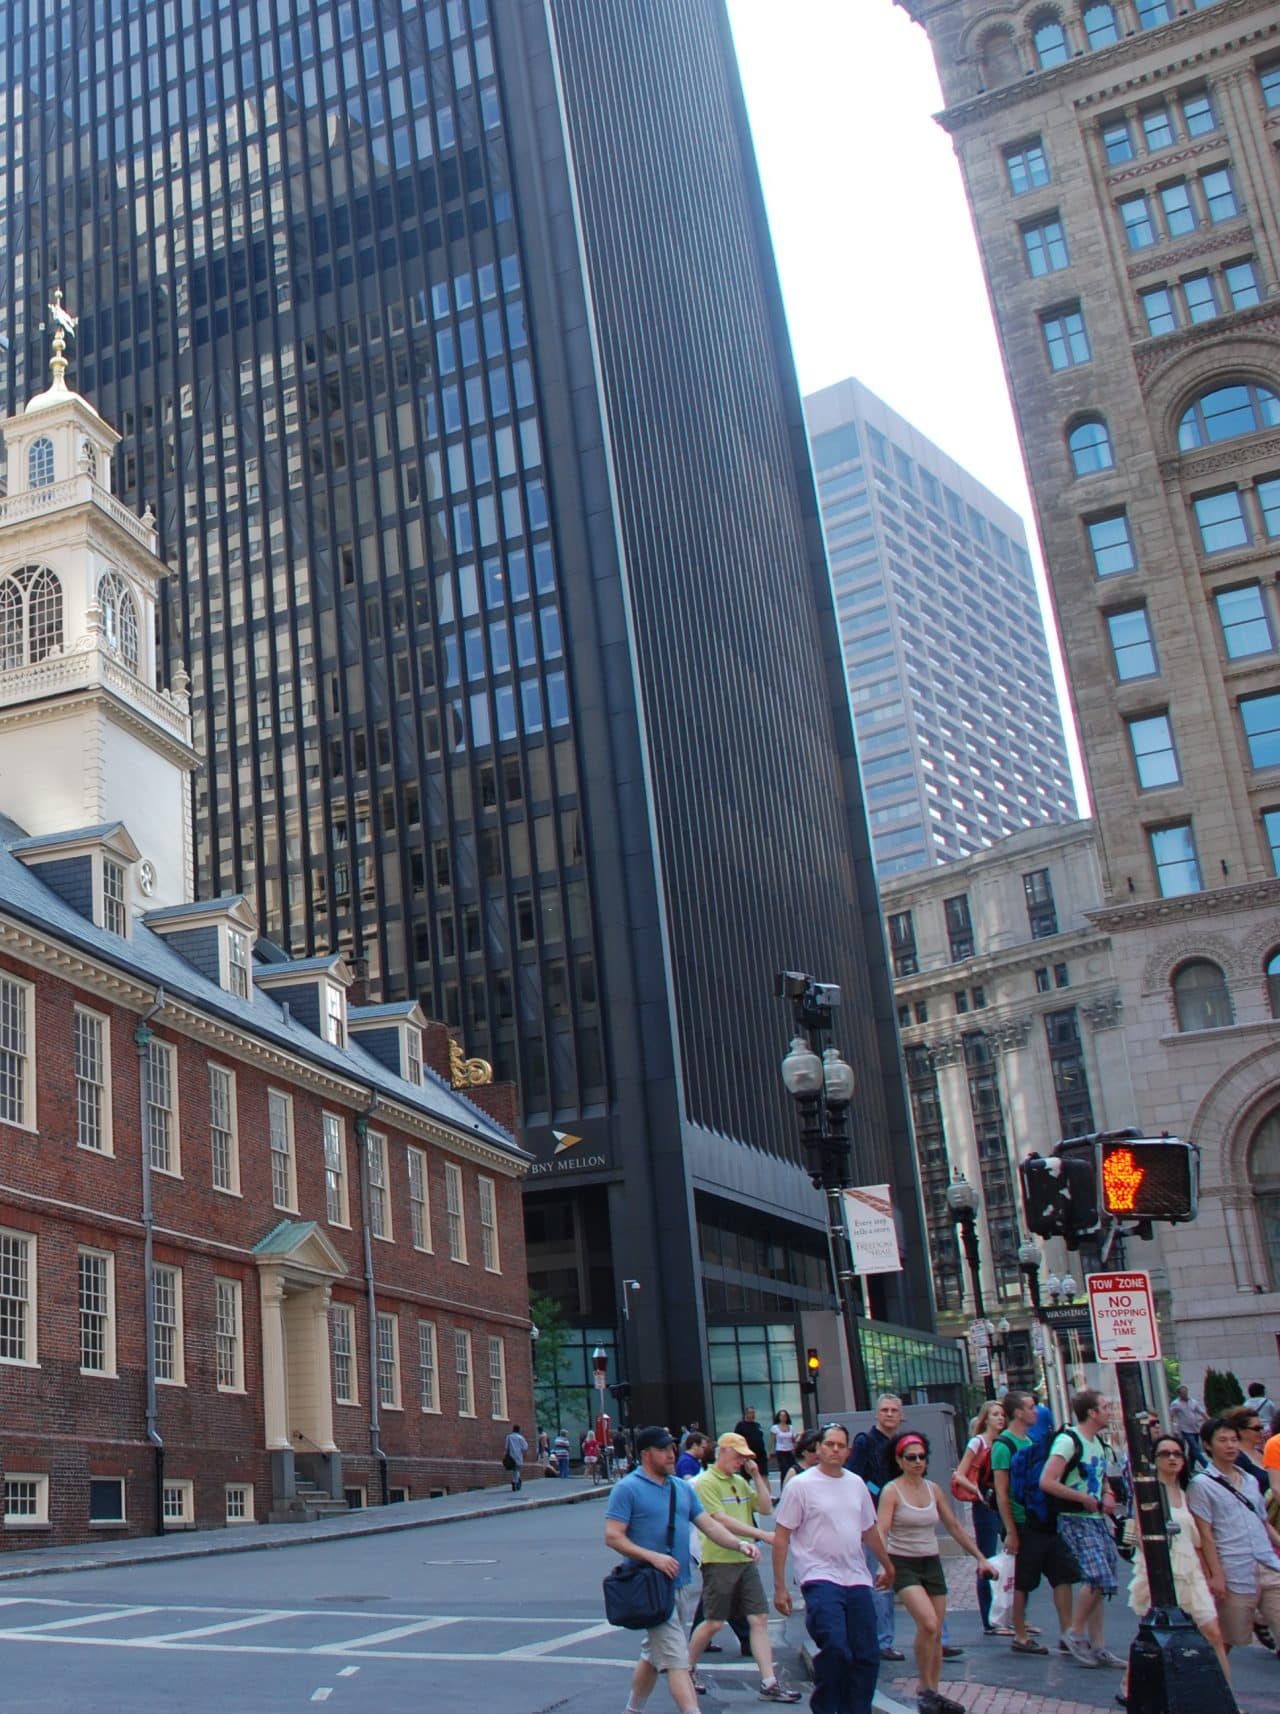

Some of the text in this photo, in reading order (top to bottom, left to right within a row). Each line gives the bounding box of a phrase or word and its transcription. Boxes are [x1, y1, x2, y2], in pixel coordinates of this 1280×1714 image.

[531, 1155, 606, 1174] BNY MELLON
[1091, 1277, 1145, 1290] TOW ZONE
[1108, 1295, 1132, 1308] NO
[1097, 1308, 1147, 1319] STOPPING
[1112, 1319, 1133, 1327] ANY
[1112, 1327, 1137, 1336] TIME
